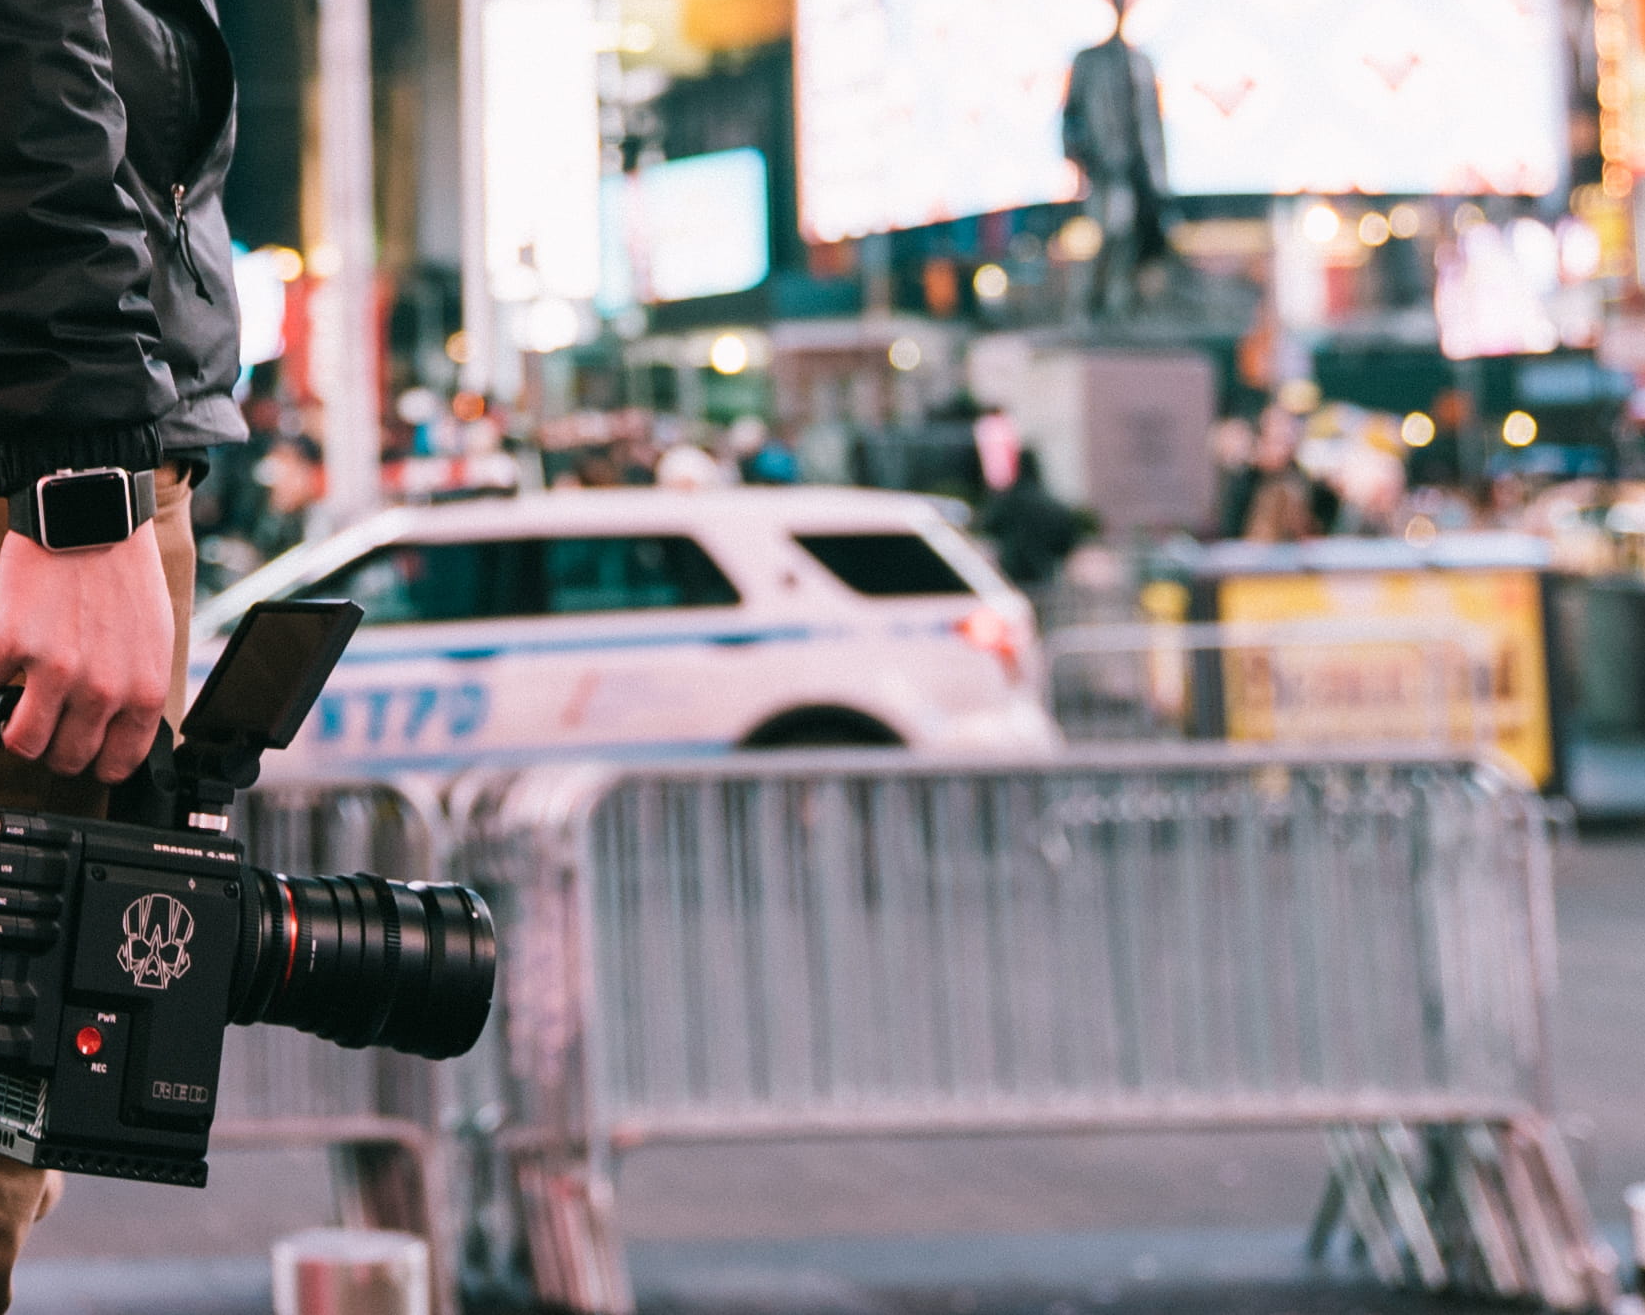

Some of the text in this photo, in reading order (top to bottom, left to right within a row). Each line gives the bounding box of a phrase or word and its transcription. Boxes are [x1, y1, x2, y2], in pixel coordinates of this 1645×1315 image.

[0, 864, 13, 874] USB
[97, 1012, 117, 1024] PWR
[90, 1062, 108, 1074] REC
